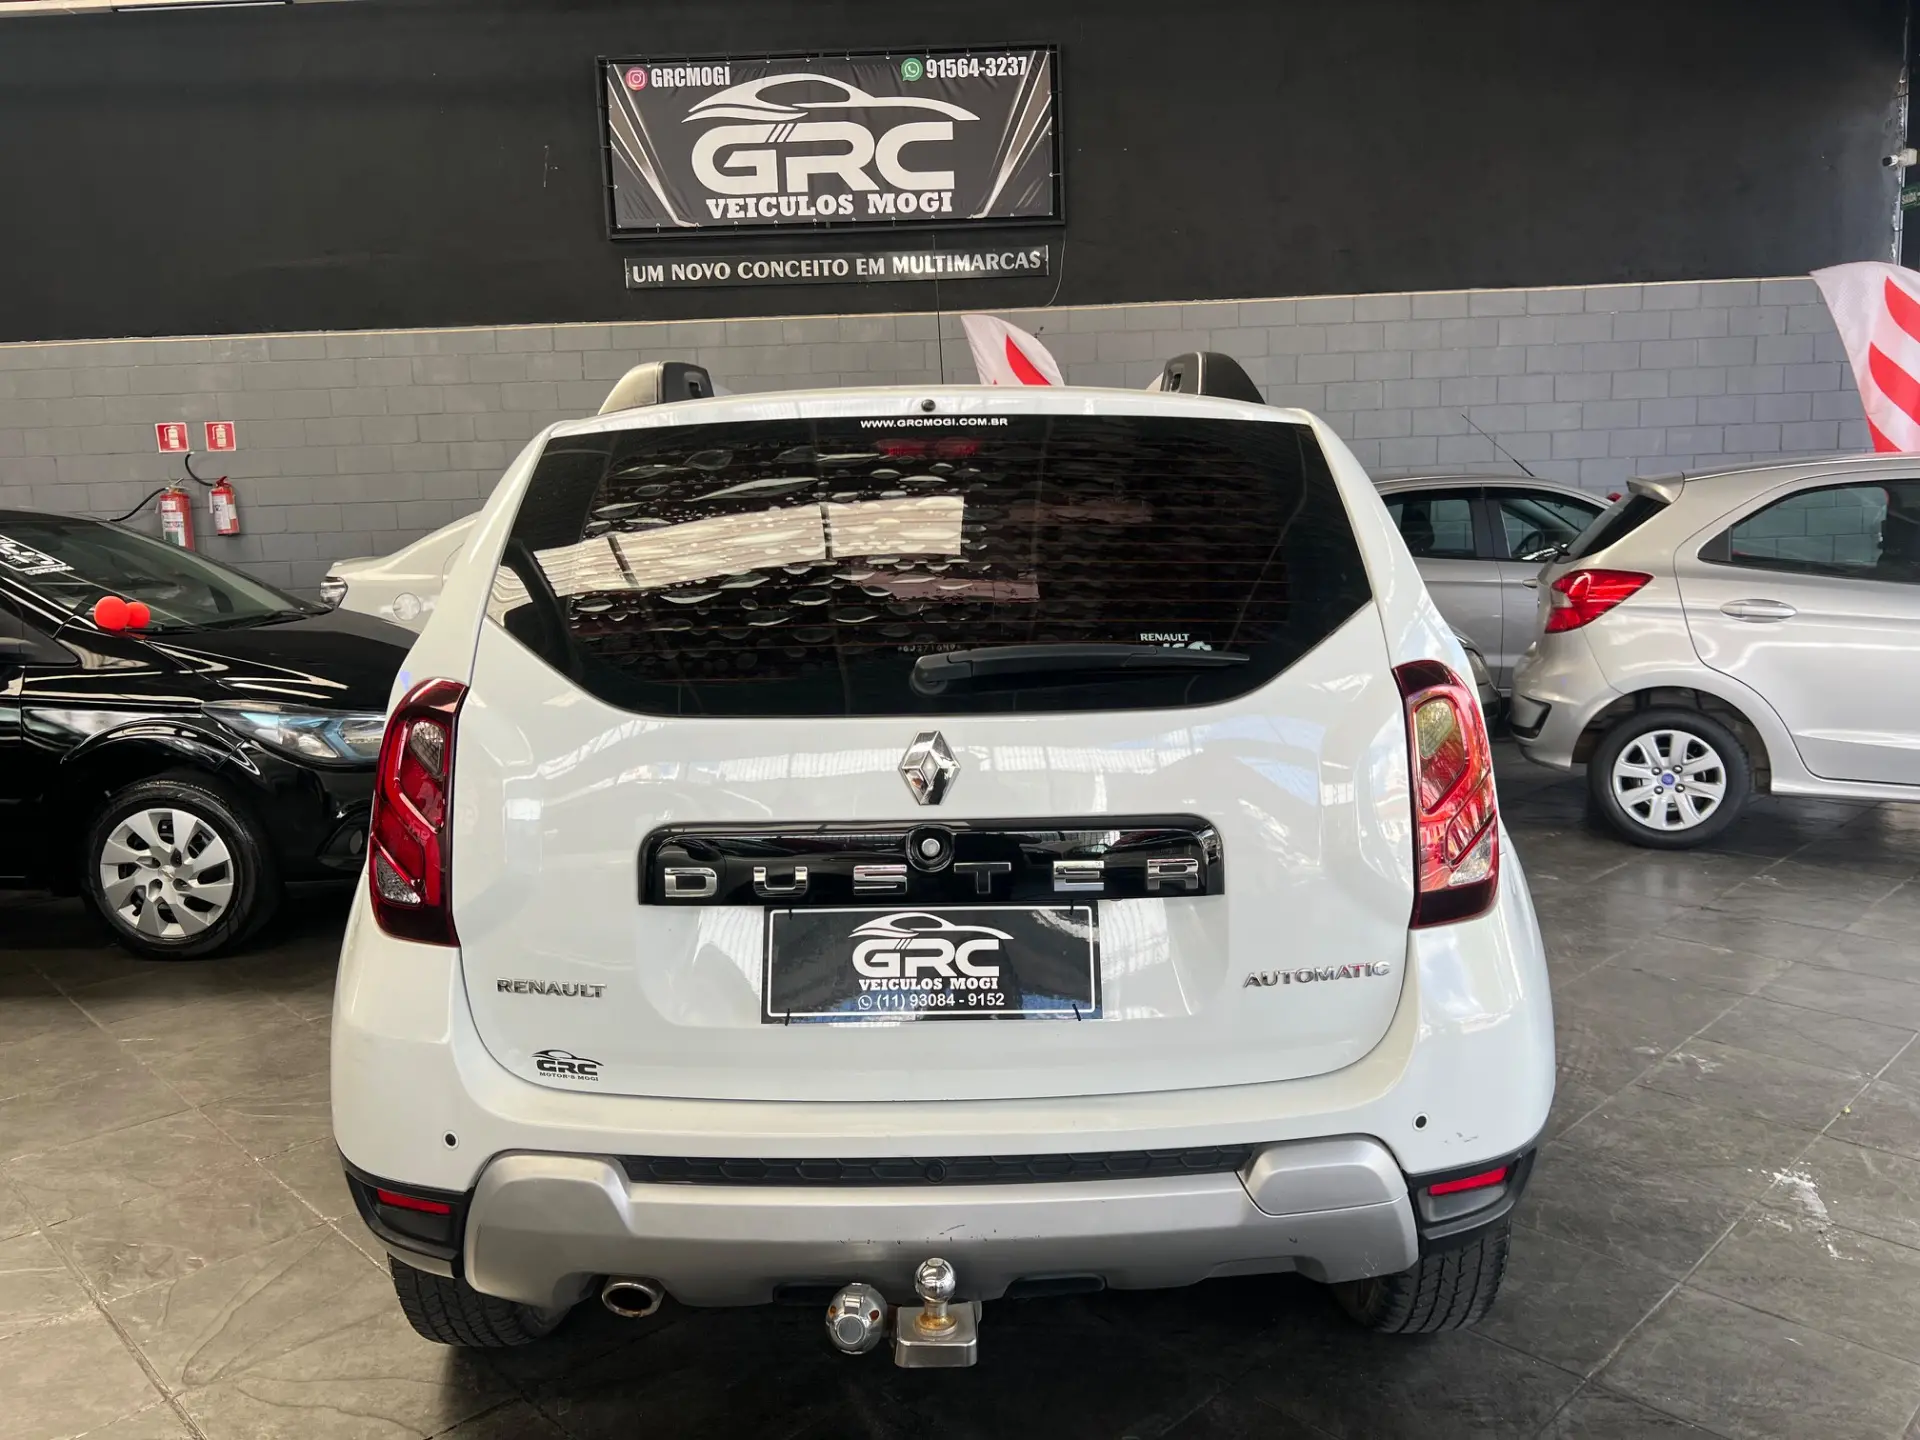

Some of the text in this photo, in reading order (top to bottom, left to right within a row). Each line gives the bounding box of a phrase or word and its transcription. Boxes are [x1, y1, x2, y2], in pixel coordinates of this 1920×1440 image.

[651, 66, 731, 88] GRCMOGI
[926, 56, 1027, 79] 91564-3237
[691, 121, 955, 194] GRC
[706, 192, 953, 219] VEICULOS MOGI
[632, 250, 1042, 283] UM NOVO CONCEITO EM MULTIMARCAS
[860, 417, 1009, 429] WWW.GRCMOGI.COM.BR
[1140, 633, 1190, 642] RENAULT
[664, 858, 1200, 899] DUSTER
[851, 938, 1000, 978] GRC
[858, 977, 999, 991] VEICULOS MOGI
[1243, 960, 1391, 988] AUTOMATIC
[496, 977, 607, 998] RENAULT
[876, 993, 906, 1010] (11)
[909, 993, 956, 1007] 93084
[967, 992, 1005, 1006] 9152
[536, 1059, 598, 1076] GRC
